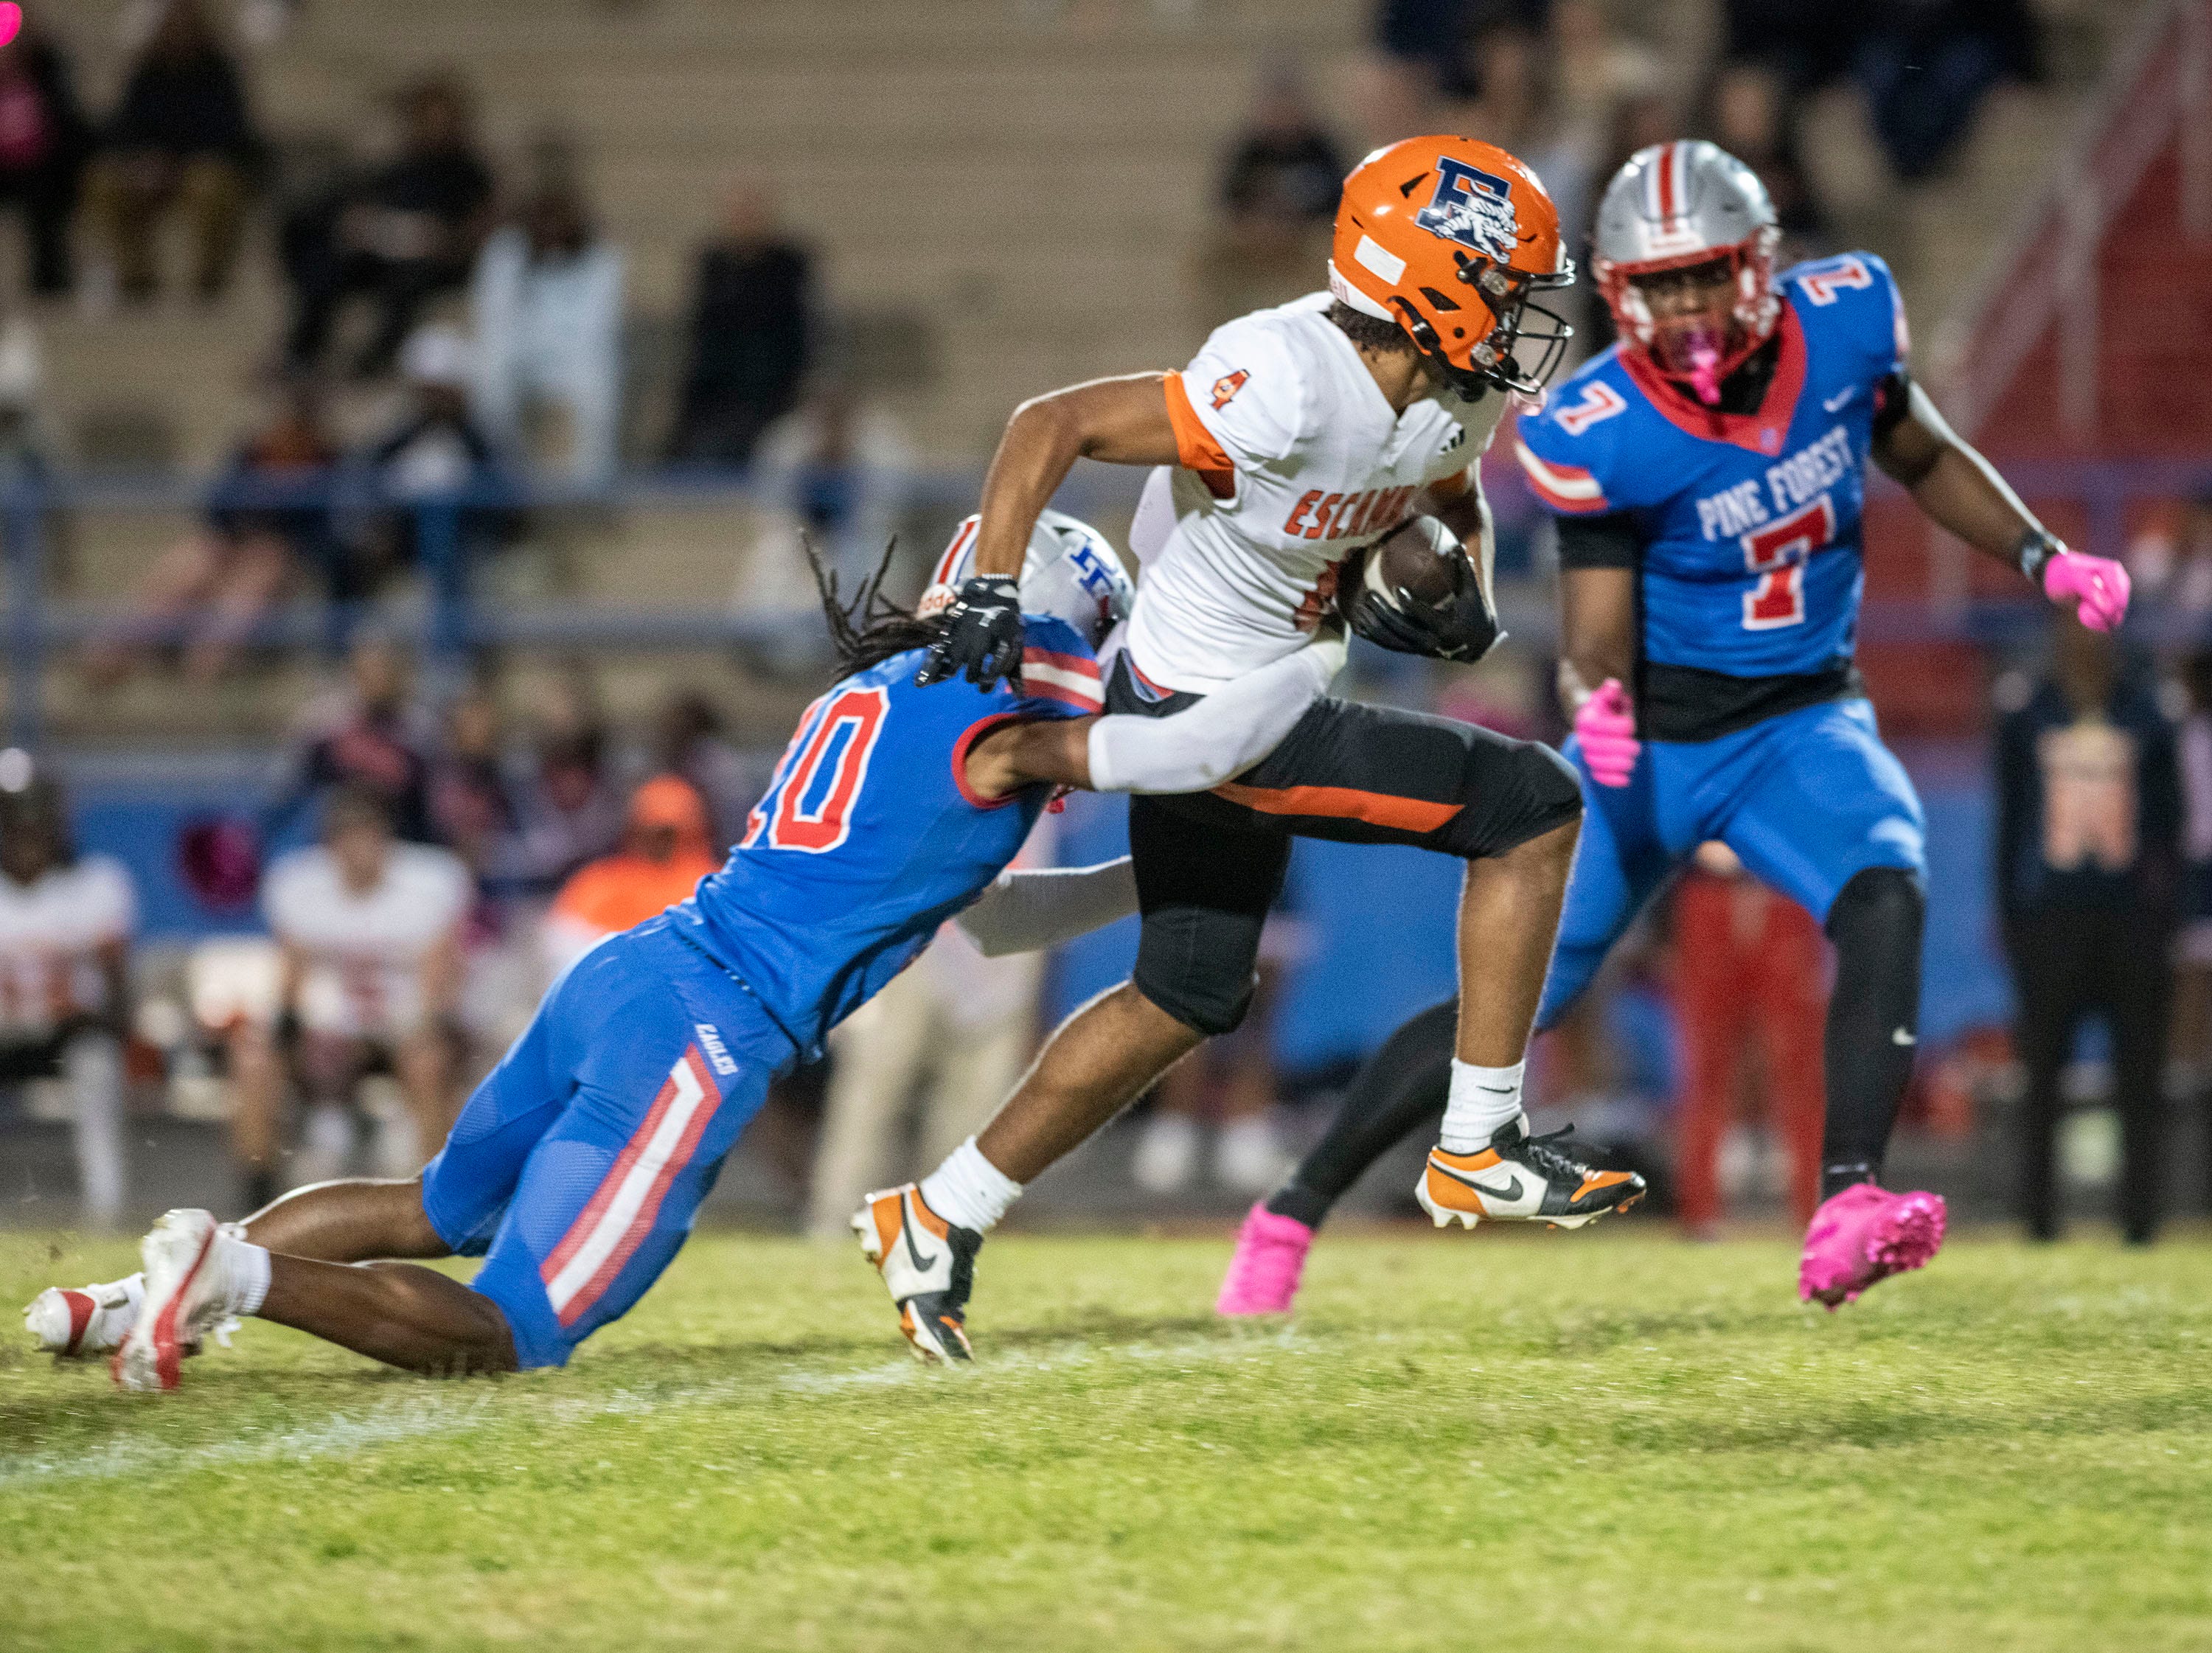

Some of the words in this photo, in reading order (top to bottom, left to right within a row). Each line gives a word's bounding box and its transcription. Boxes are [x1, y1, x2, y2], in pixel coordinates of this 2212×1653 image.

[1798, 256, 1874, 307] 7
[1211, 369, 1251, 411] 4
[1554, 380, 1628, 436] 7
[1696, 479, 1769, 542] PINE
[1766, 425, 1854, 513] FOREST
[1741, 492, 1836, 631] 7
